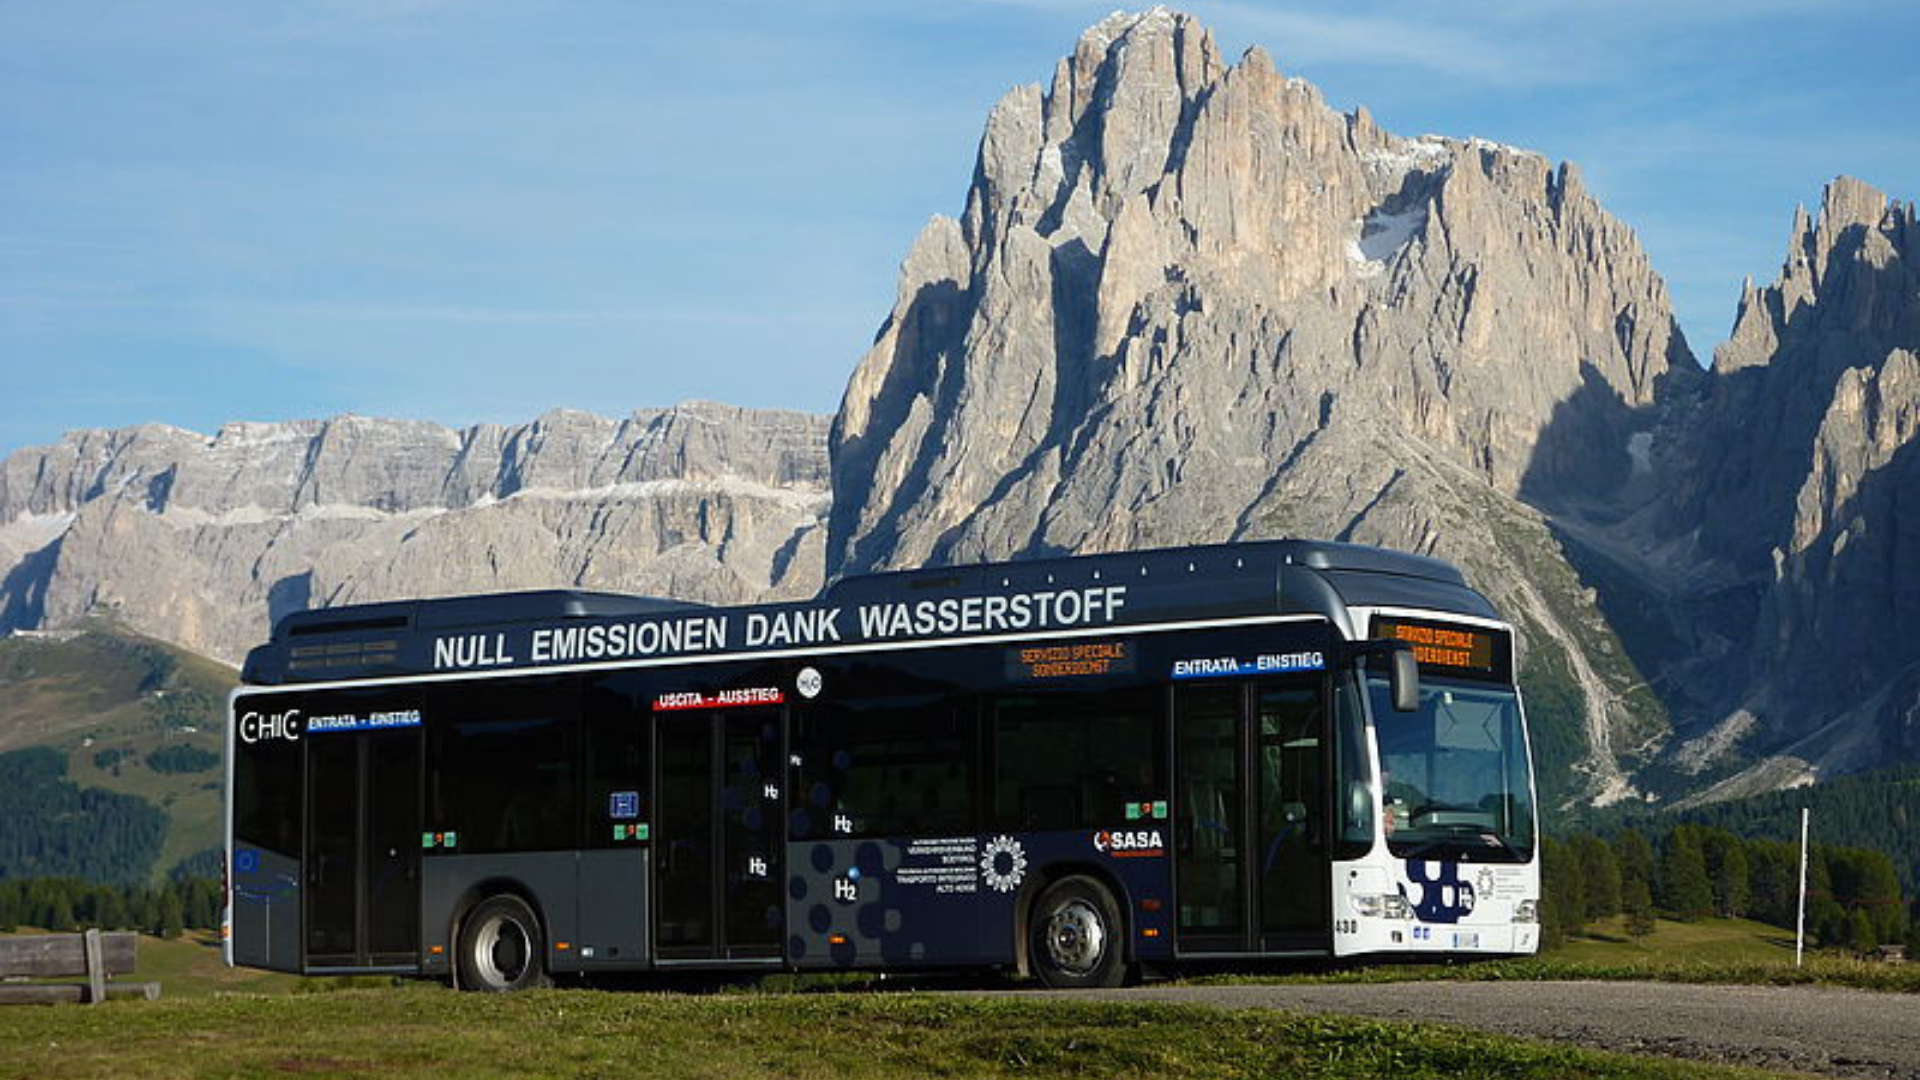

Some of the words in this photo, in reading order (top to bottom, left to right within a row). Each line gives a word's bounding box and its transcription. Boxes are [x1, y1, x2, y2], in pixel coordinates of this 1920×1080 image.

[434, 634, 514, 669] NULL
[531, 616, 727, 661] EMISSIONEN
[745, 608, 841, 646] DANK
[859, 587, 1127, 638] WASSERSTOFF
[1174, 657, 1238, 675] ENTRATA
[1257, 652, 1324, 670] EINSTIEG
[659, 692, 703, 708] USCITA
[717, 687, 779, 703] AUSSTIEG
[240, 709, 300, 743] CHIC
[308, 714, 356, 730] ENTRATA
[369, 709, 421, 726] EINSTIEG
[1111, 830, 1164, 849] SASA
